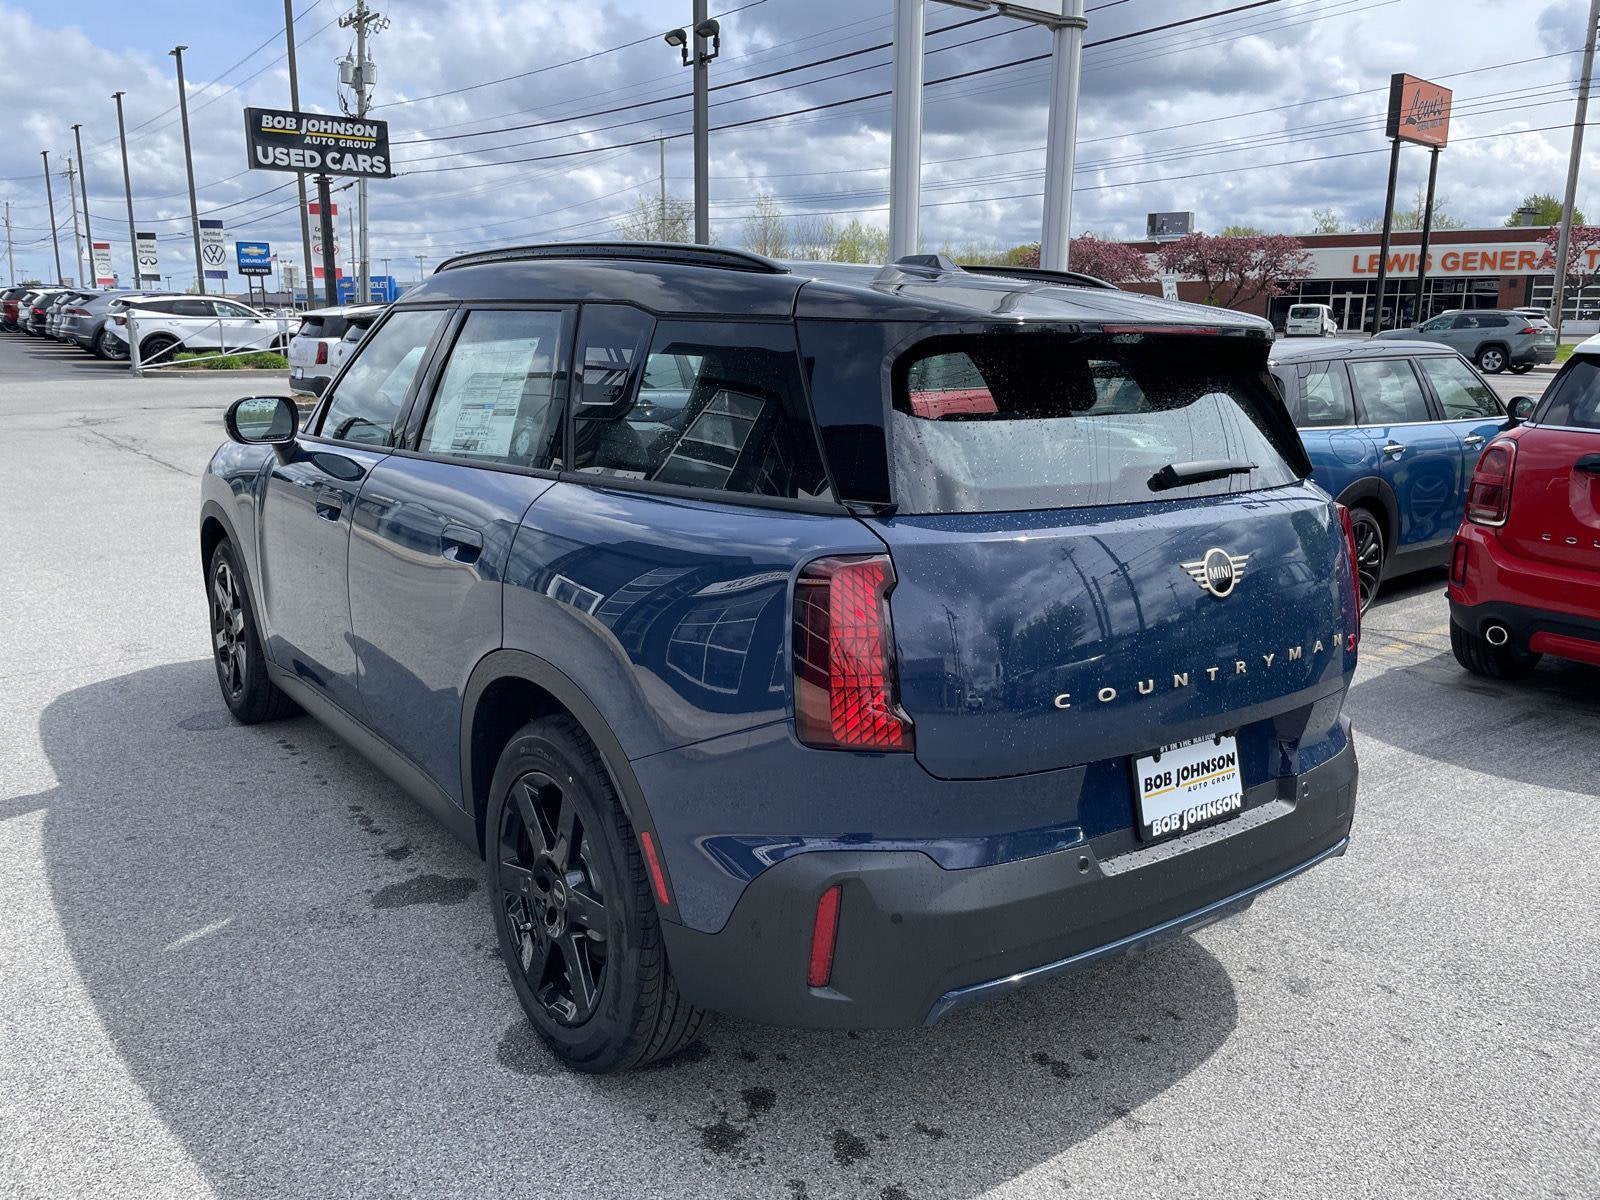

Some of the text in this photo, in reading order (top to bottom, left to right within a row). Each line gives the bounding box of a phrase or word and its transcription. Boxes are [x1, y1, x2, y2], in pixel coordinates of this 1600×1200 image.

[261, 114, 378, 138] BOB JOHNSON
[304, 135, 377, 150] AUTO GROUP
[256, 145, 387, 174] USED CARS
[1441, 250, 1556, 272] GENERA
[1208, 565, 1232, 580] MINI
[1054, 633, 1343, 709] COUNTRYMAN
[1170, 742, 1178, 751] IN
[1178, 739, 1192, 748] THE
[1192, 732, 1216, 745] NATION
[1144, 752, 1236, 793] BOB JOHNSON
[1187, 772, 1236, 793] AUTO GROUP
[1152, 793, 1242, 836] BOB JOHNSON
